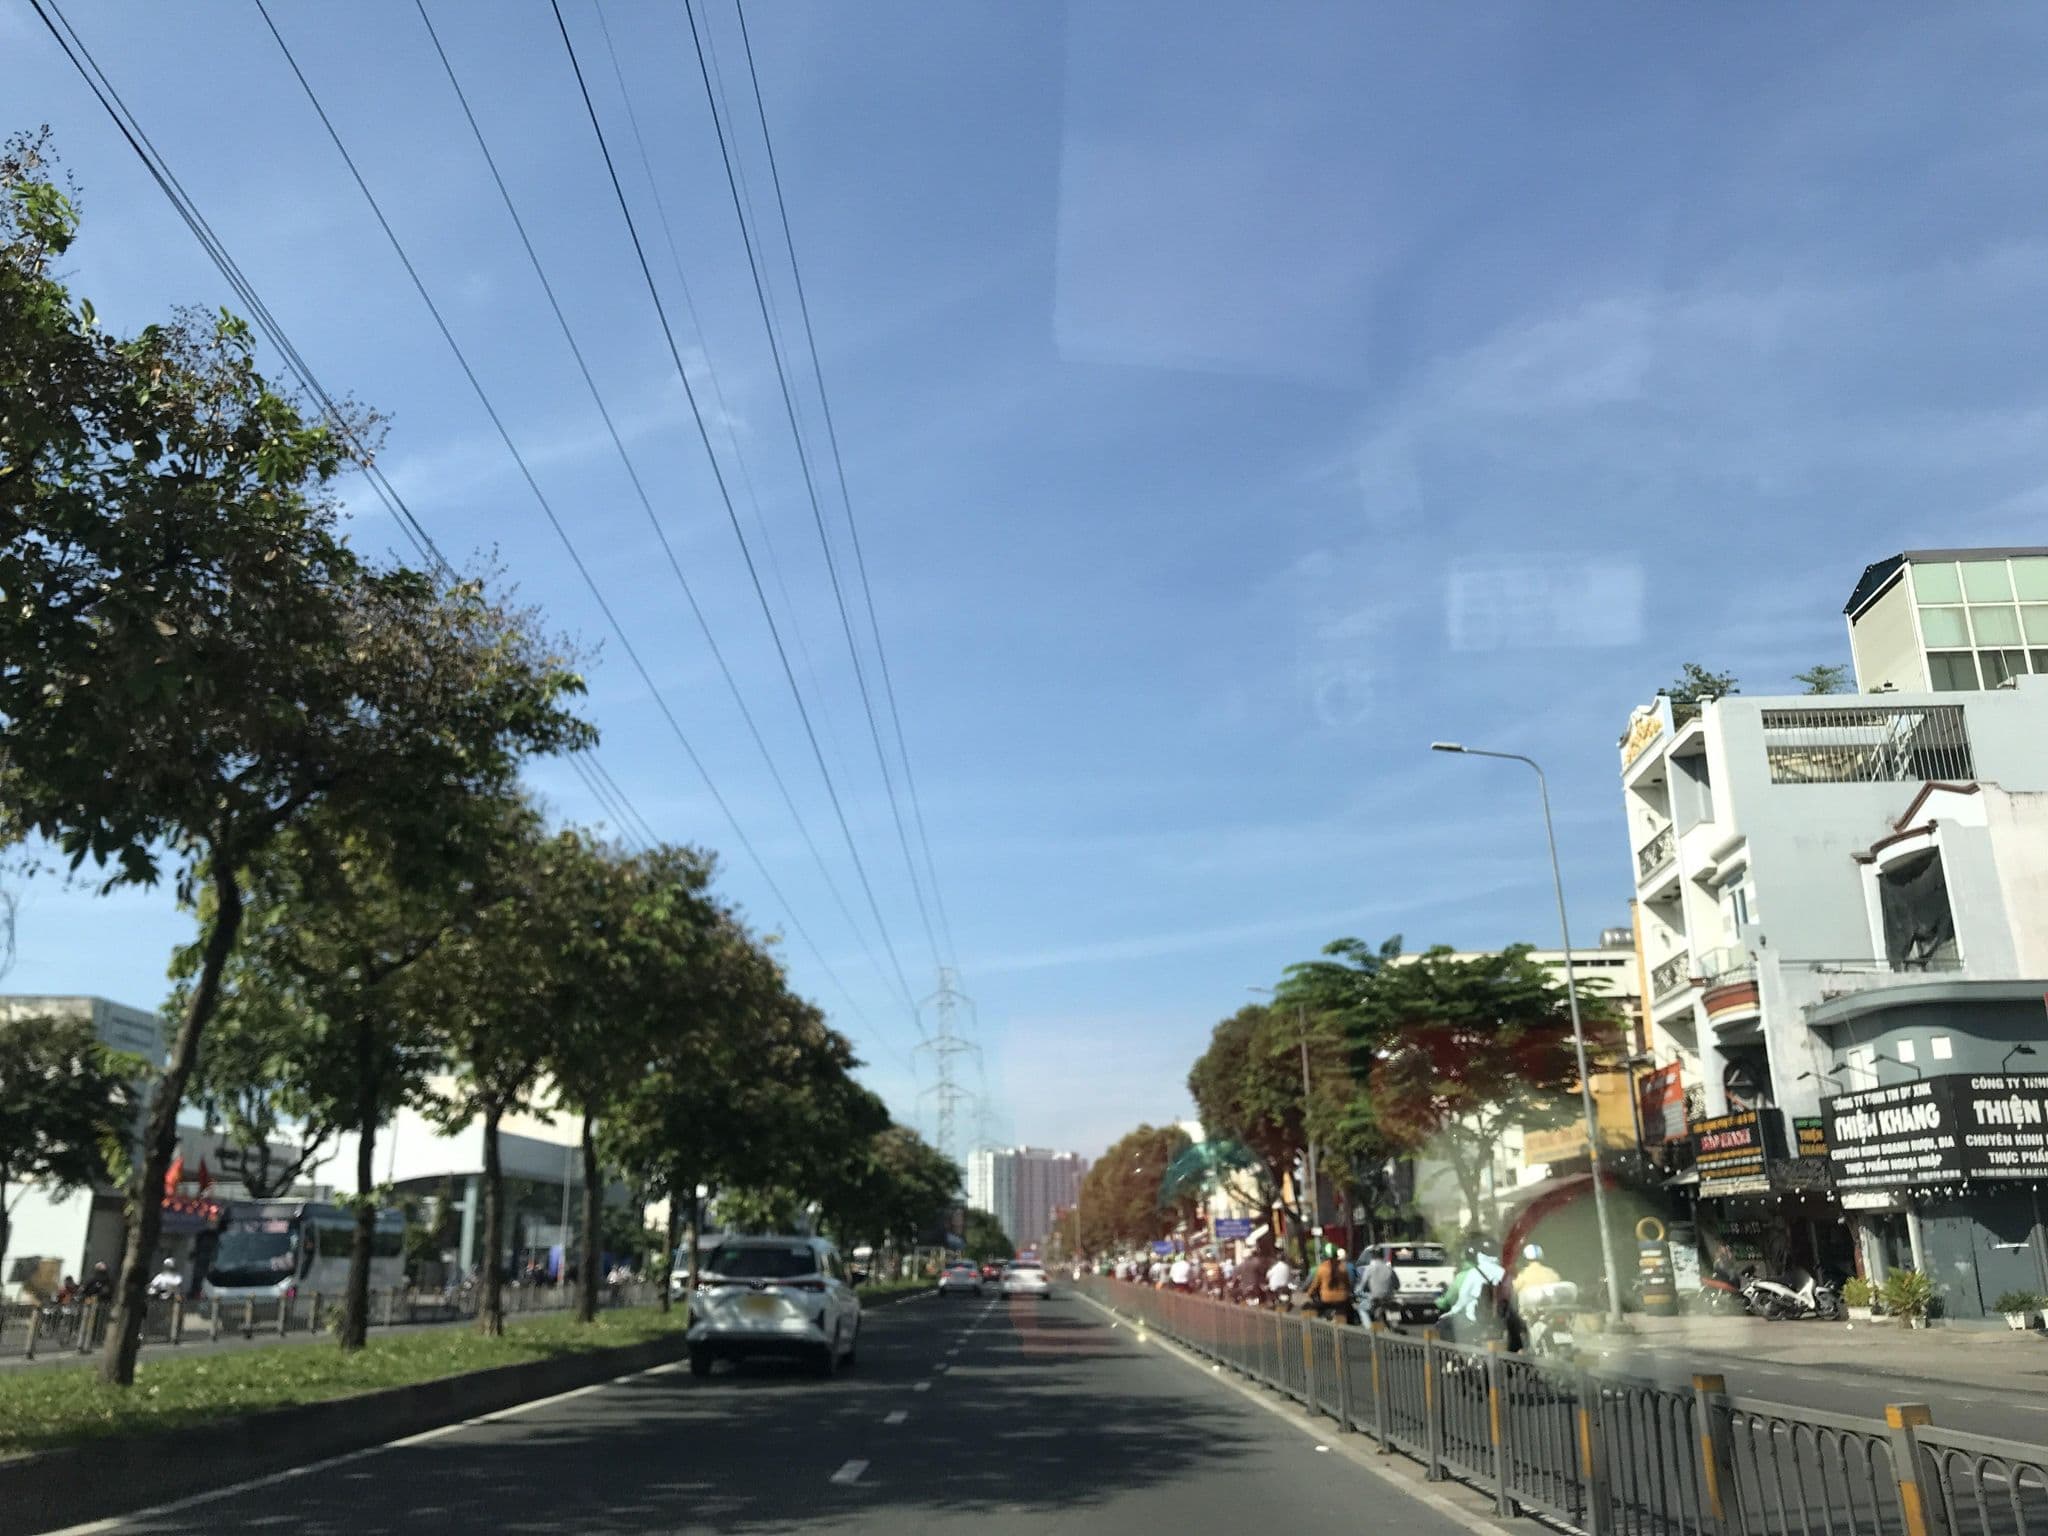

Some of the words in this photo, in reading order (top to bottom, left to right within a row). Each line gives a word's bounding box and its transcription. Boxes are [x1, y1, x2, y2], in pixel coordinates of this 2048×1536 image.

[1971, 1076, 2004, 1090] CÔNG
[2006, 1077, 2020, 1090] TY
[1973, 1094, 2042, 1130] THIỆN
[1835, 1108, 1879, 1144] THIỆN
[1879, 1102, 1940, 1135] KHANG
[1965, 1132, 2013, 1147] CHUYÊN
[2014, 1134, 2044, 1146] KINH
[1988, 1151, 2019, 1166] THỰC
